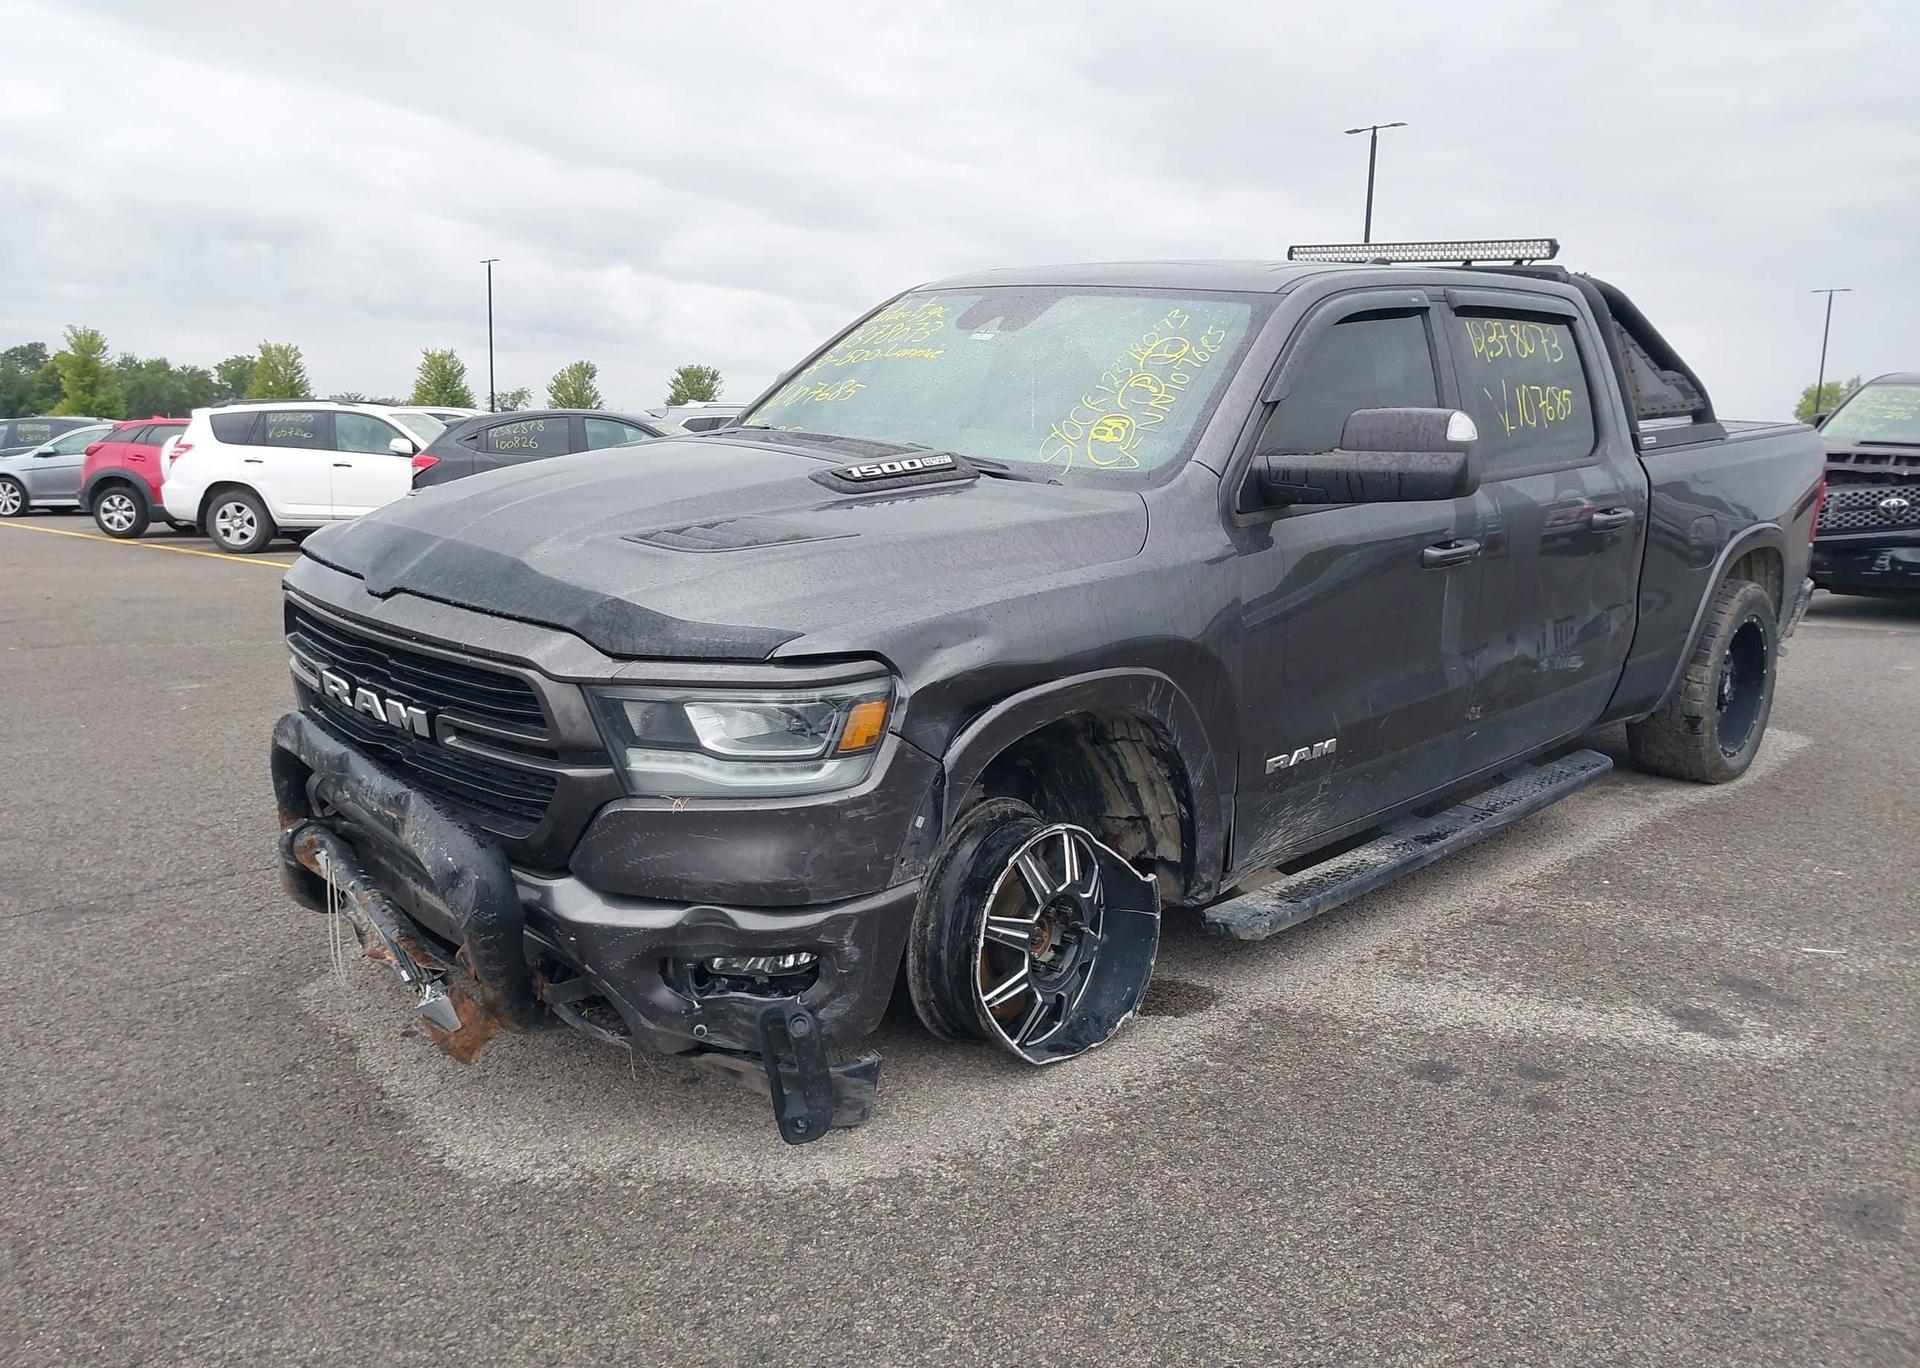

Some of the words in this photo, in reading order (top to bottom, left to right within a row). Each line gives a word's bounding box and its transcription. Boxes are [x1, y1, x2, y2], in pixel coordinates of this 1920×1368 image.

[495, 435, 539, 450] 100826
[846, 458, 922, 478] 1500
[321, 670, 431, 738] RAM
[1264, 738, 1337, 775] RAM
